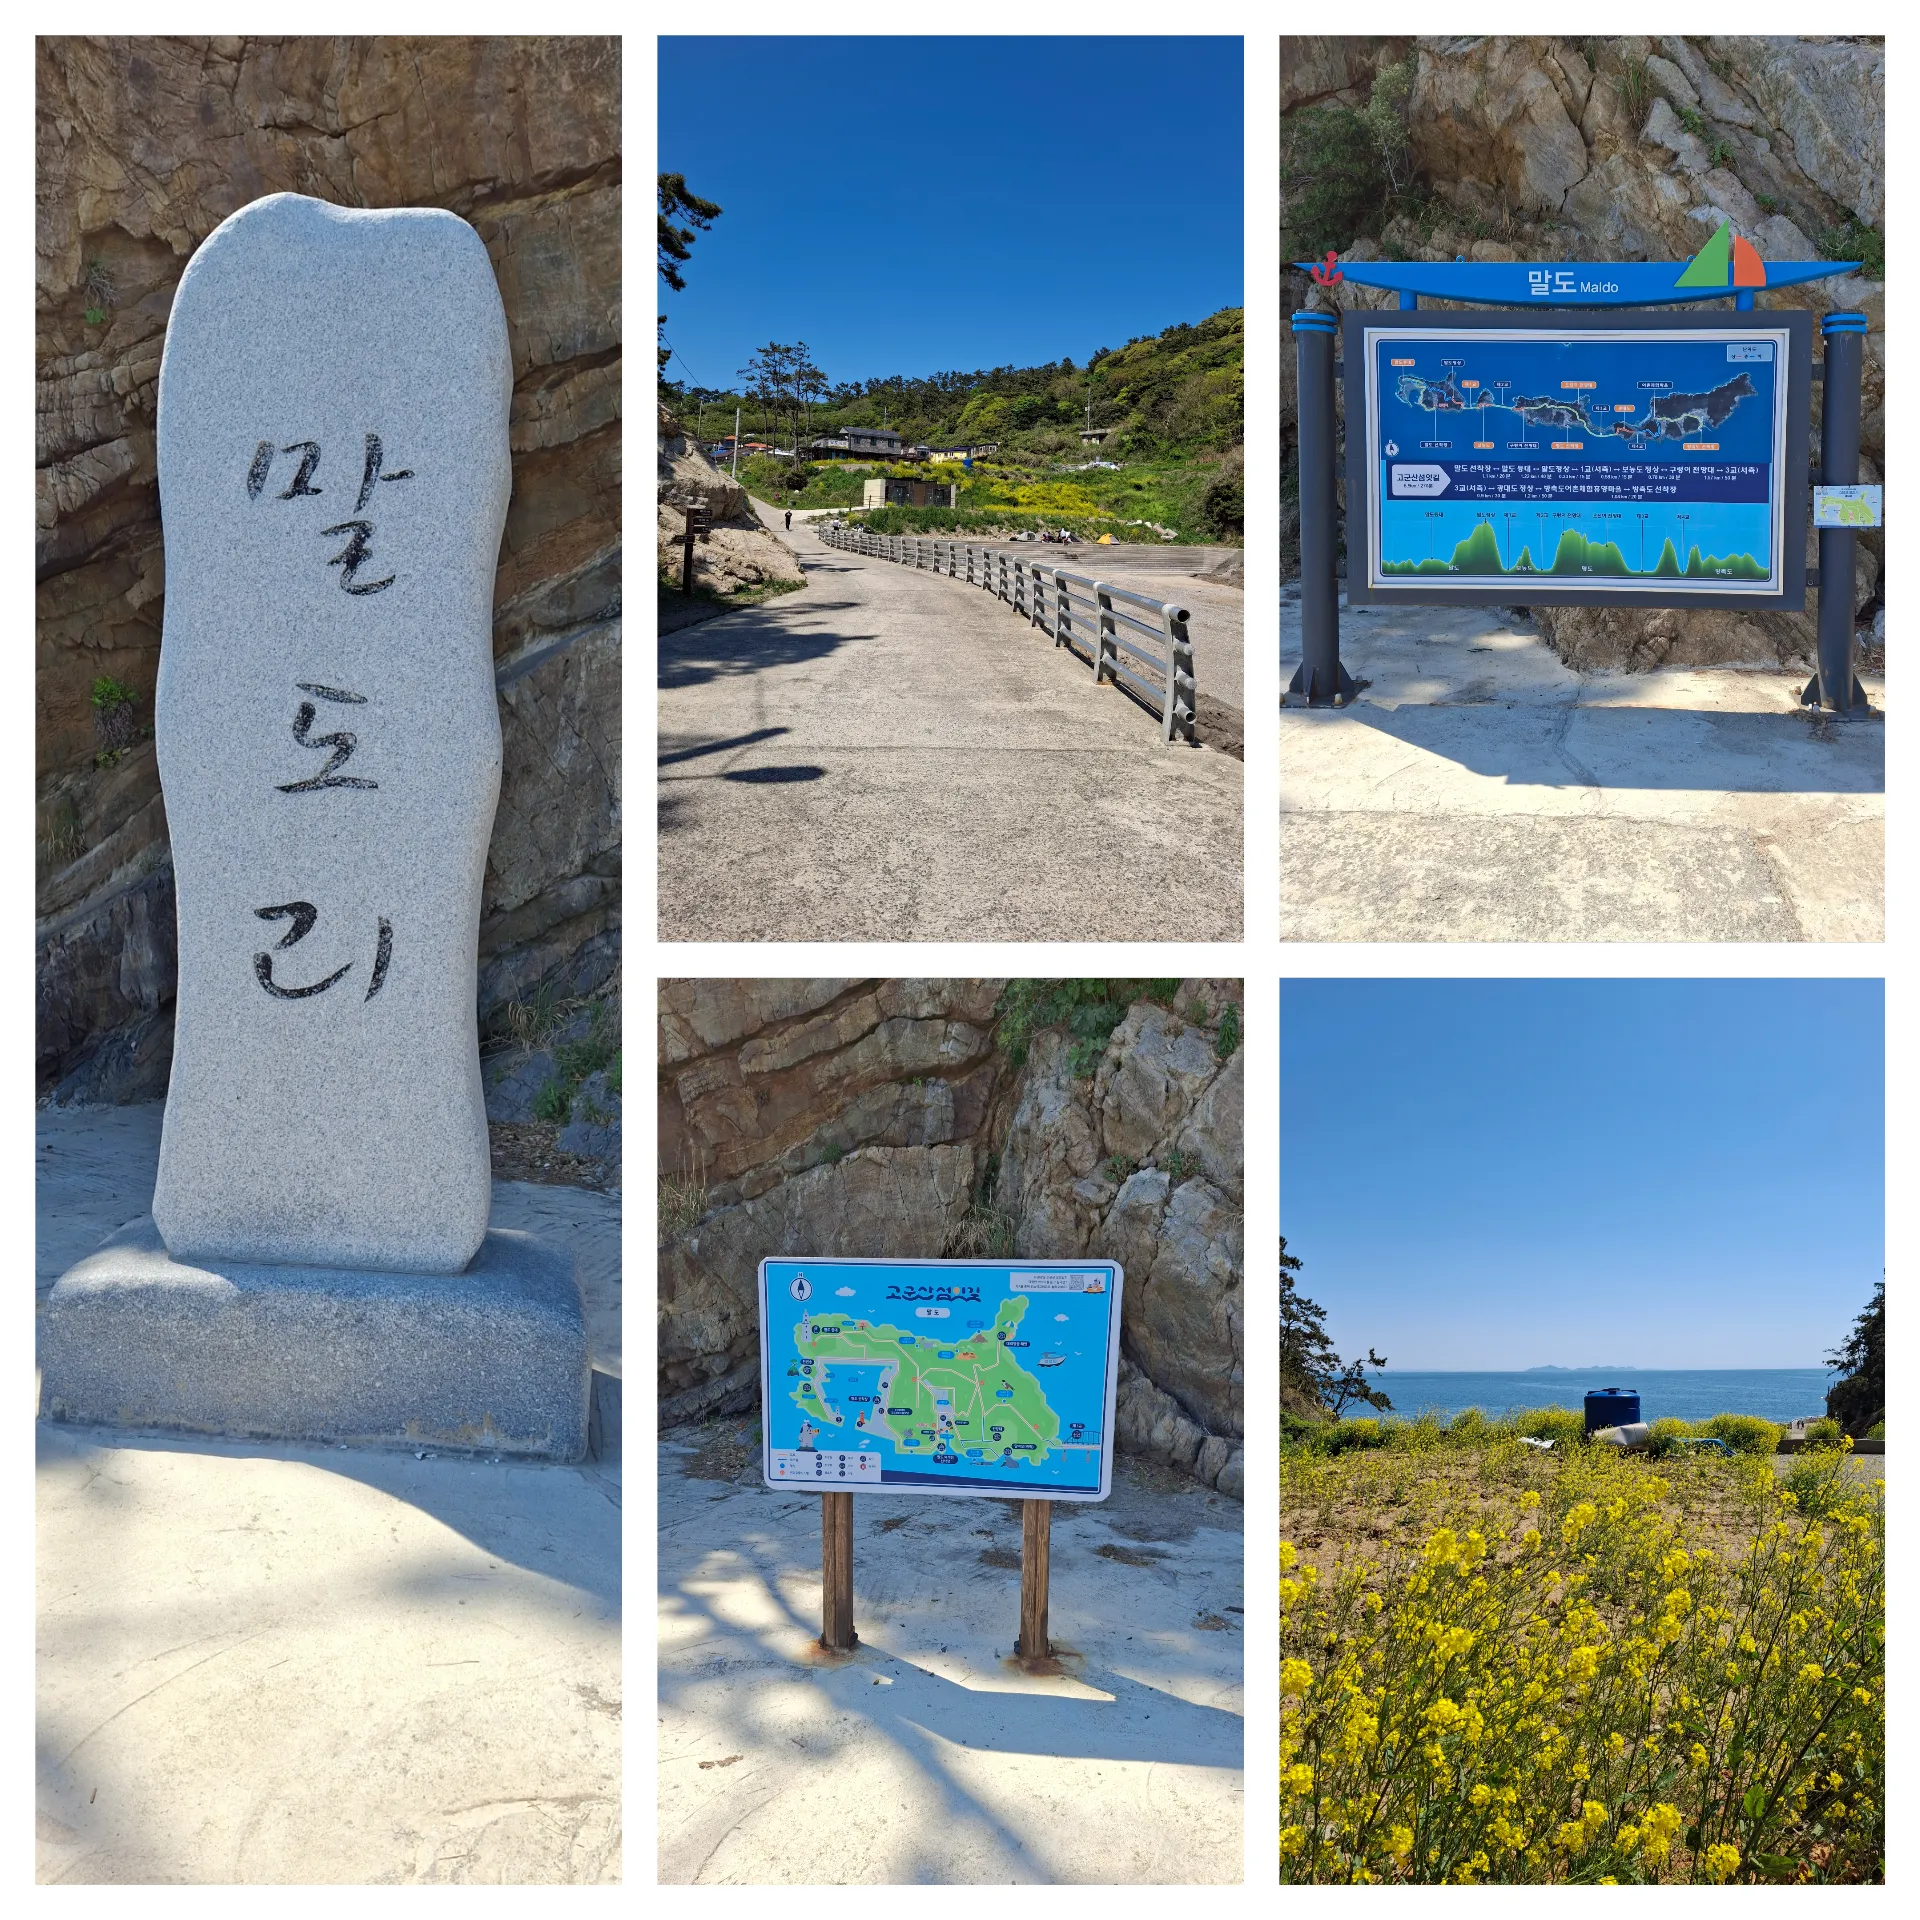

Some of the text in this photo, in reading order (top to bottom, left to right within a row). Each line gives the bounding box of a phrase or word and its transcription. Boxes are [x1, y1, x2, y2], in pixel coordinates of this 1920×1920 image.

[1528, 269, 1619, 296] 말도 Maldo
[1454, 464, 1468, 473] 말도
[1470, 464, 1491, 473] 선착장
[1502, 464, 1516, 473] 말도
[1517, 464, 1531, 473] 등대
[1622, 465, 1643, 474] 보농도
[1645, 465, 1659, 474] 정상
[1669, 466, 1691, 474] 구렁이
[1693, 466, 1715, 474] 전망대
[1397, 473, 1440, 482] 고군산섬잇길
[1496, 484, 1518, 493] 광대도
[1520, 484, 1534, 493] 정상
[1632, 485, 1653, 494] 방축도
[1655, 485, 1677, 494] 선착장
[247, 432, 415, 1003] 말도리
